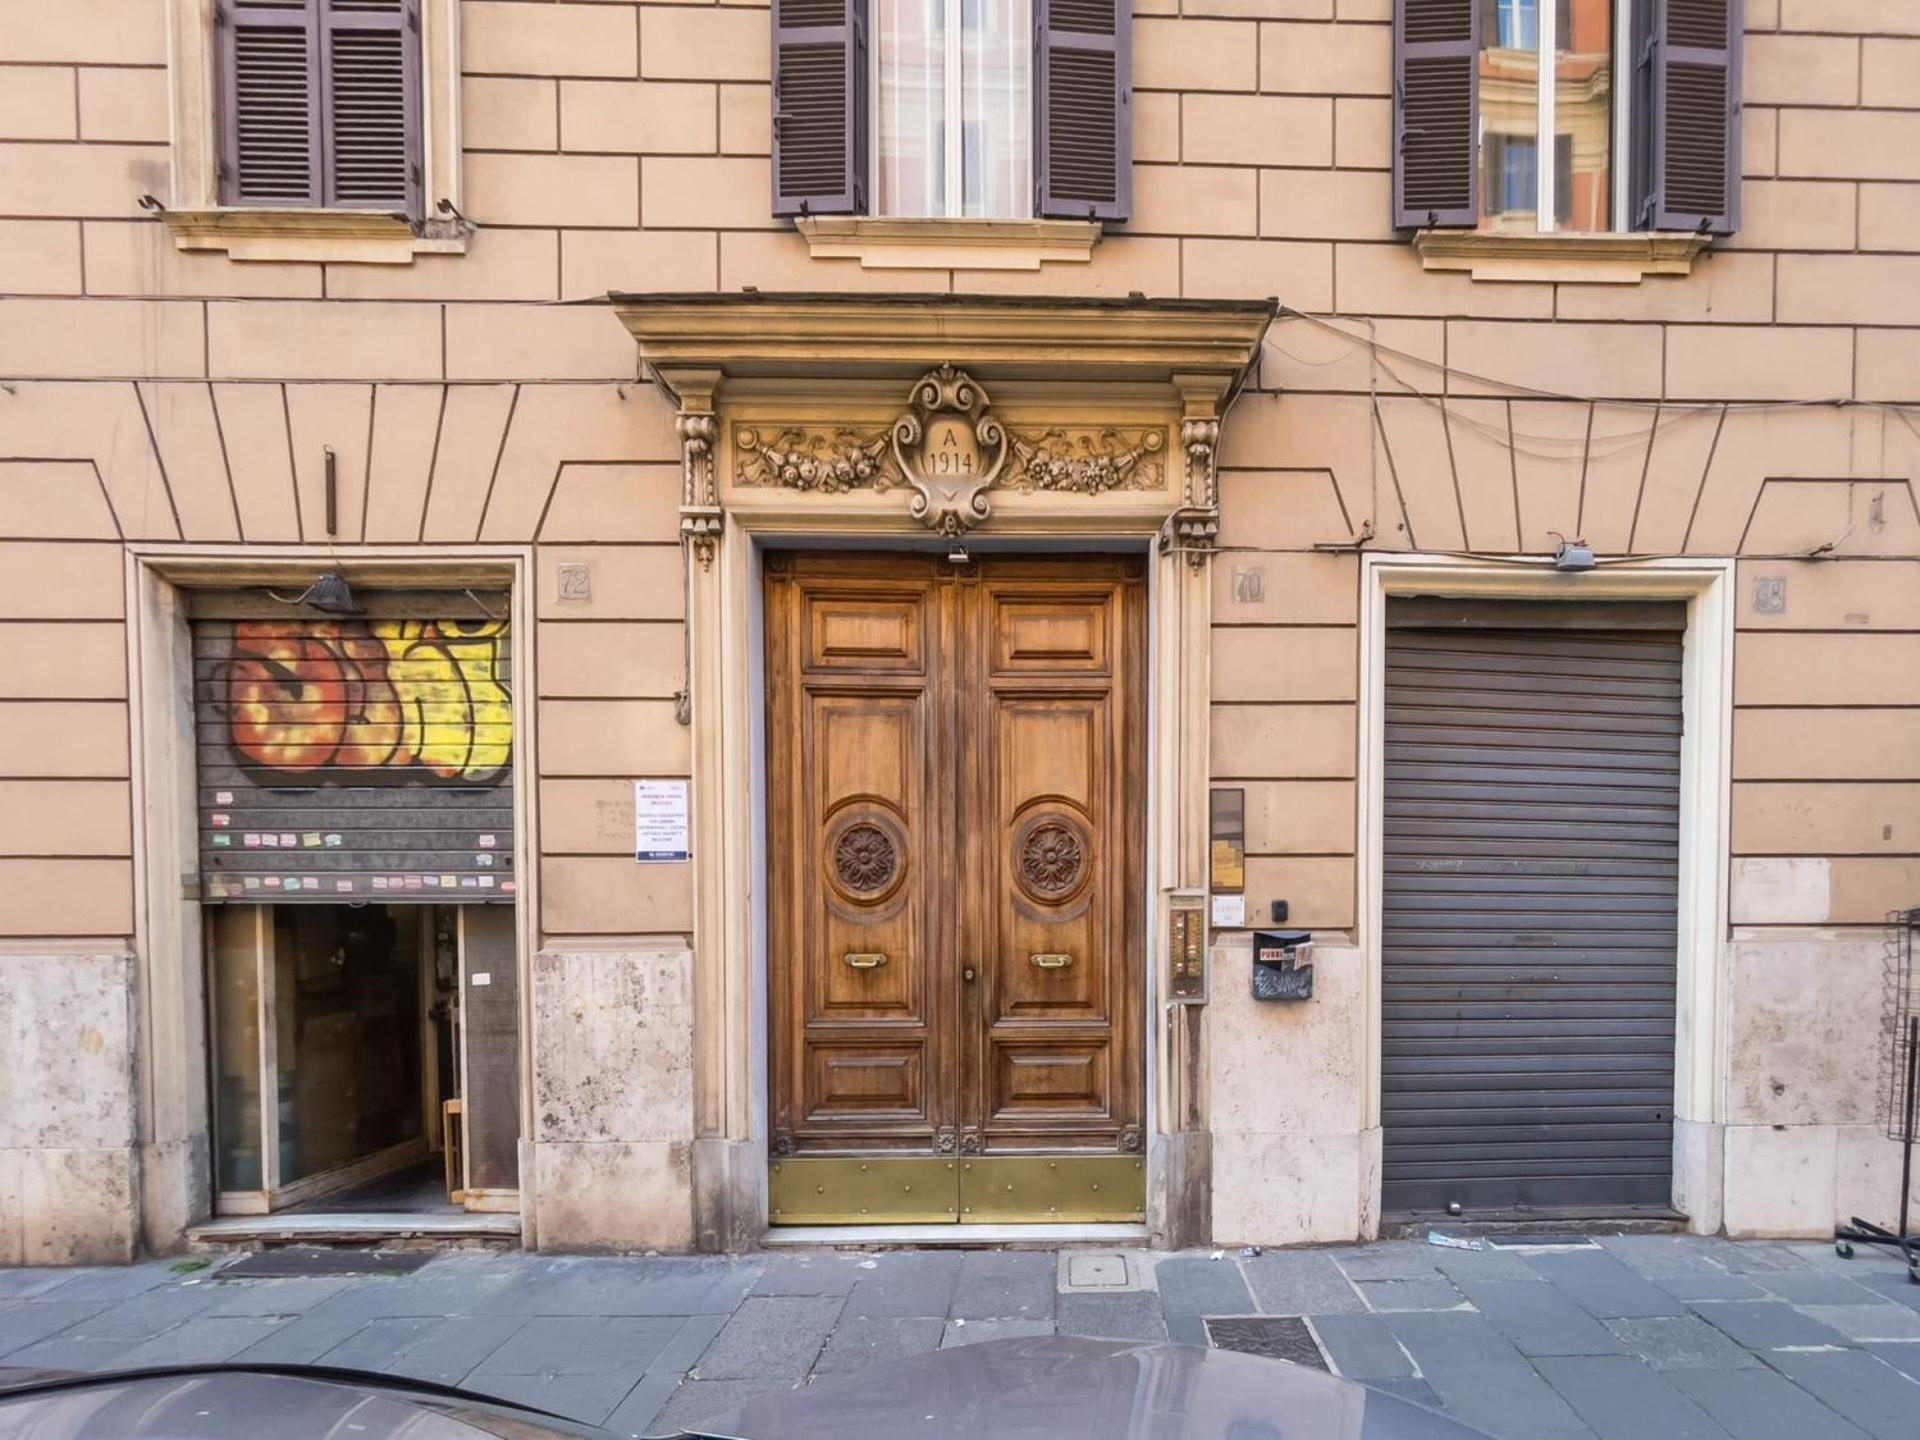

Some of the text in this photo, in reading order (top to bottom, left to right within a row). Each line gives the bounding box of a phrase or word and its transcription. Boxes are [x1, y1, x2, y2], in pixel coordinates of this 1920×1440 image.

[943, 428, 957, 446] A
[930, 451, 972, 474] 1914
[561, 569, 588, 594] 72
[1235, 572, 1261, 598] 70
